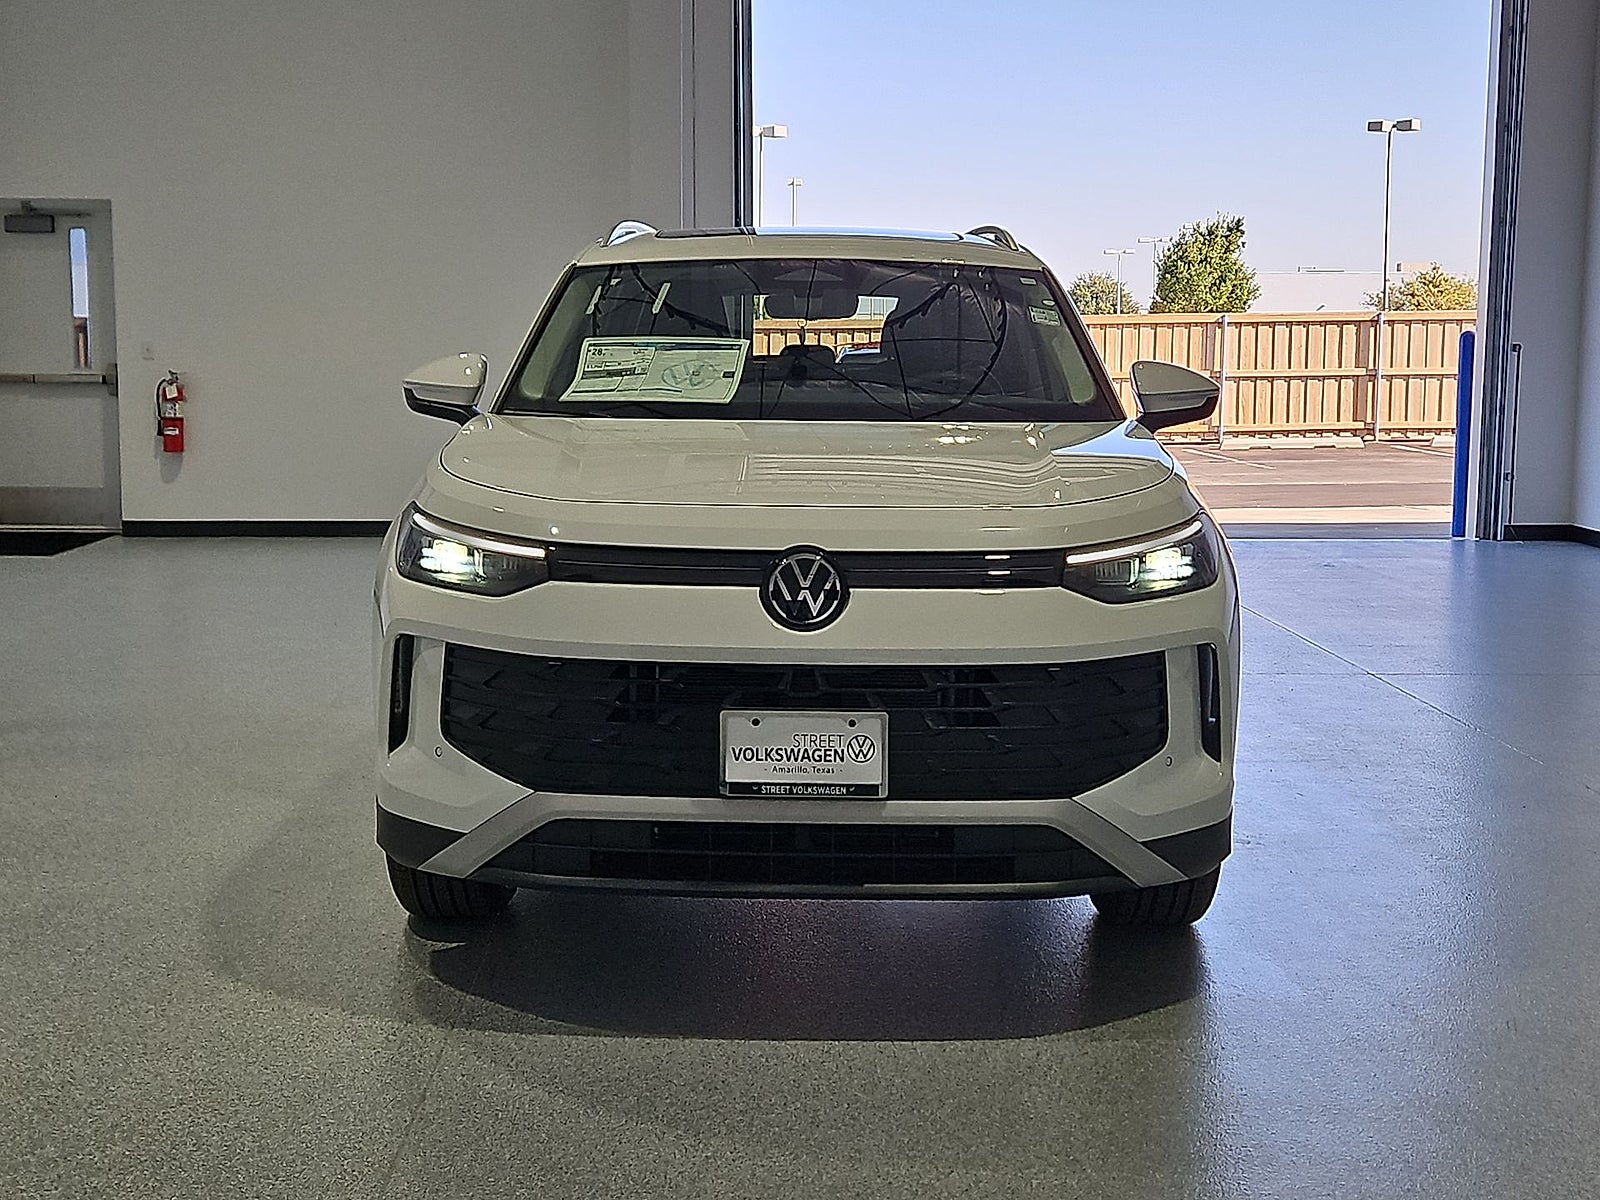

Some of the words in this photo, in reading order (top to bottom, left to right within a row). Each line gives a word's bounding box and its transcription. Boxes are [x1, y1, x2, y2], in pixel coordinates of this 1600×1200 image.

[792, 734, 845, 748] STREET
[731, 746, 845, 763] VOLKSWAGEN
[771, 765, 810, 774] Amarillo,
[812, 766, 835, 774] Texas
[761, 786, 790, 794] STREET
[792, 786, 847, 795] VOLKSWAGEN
